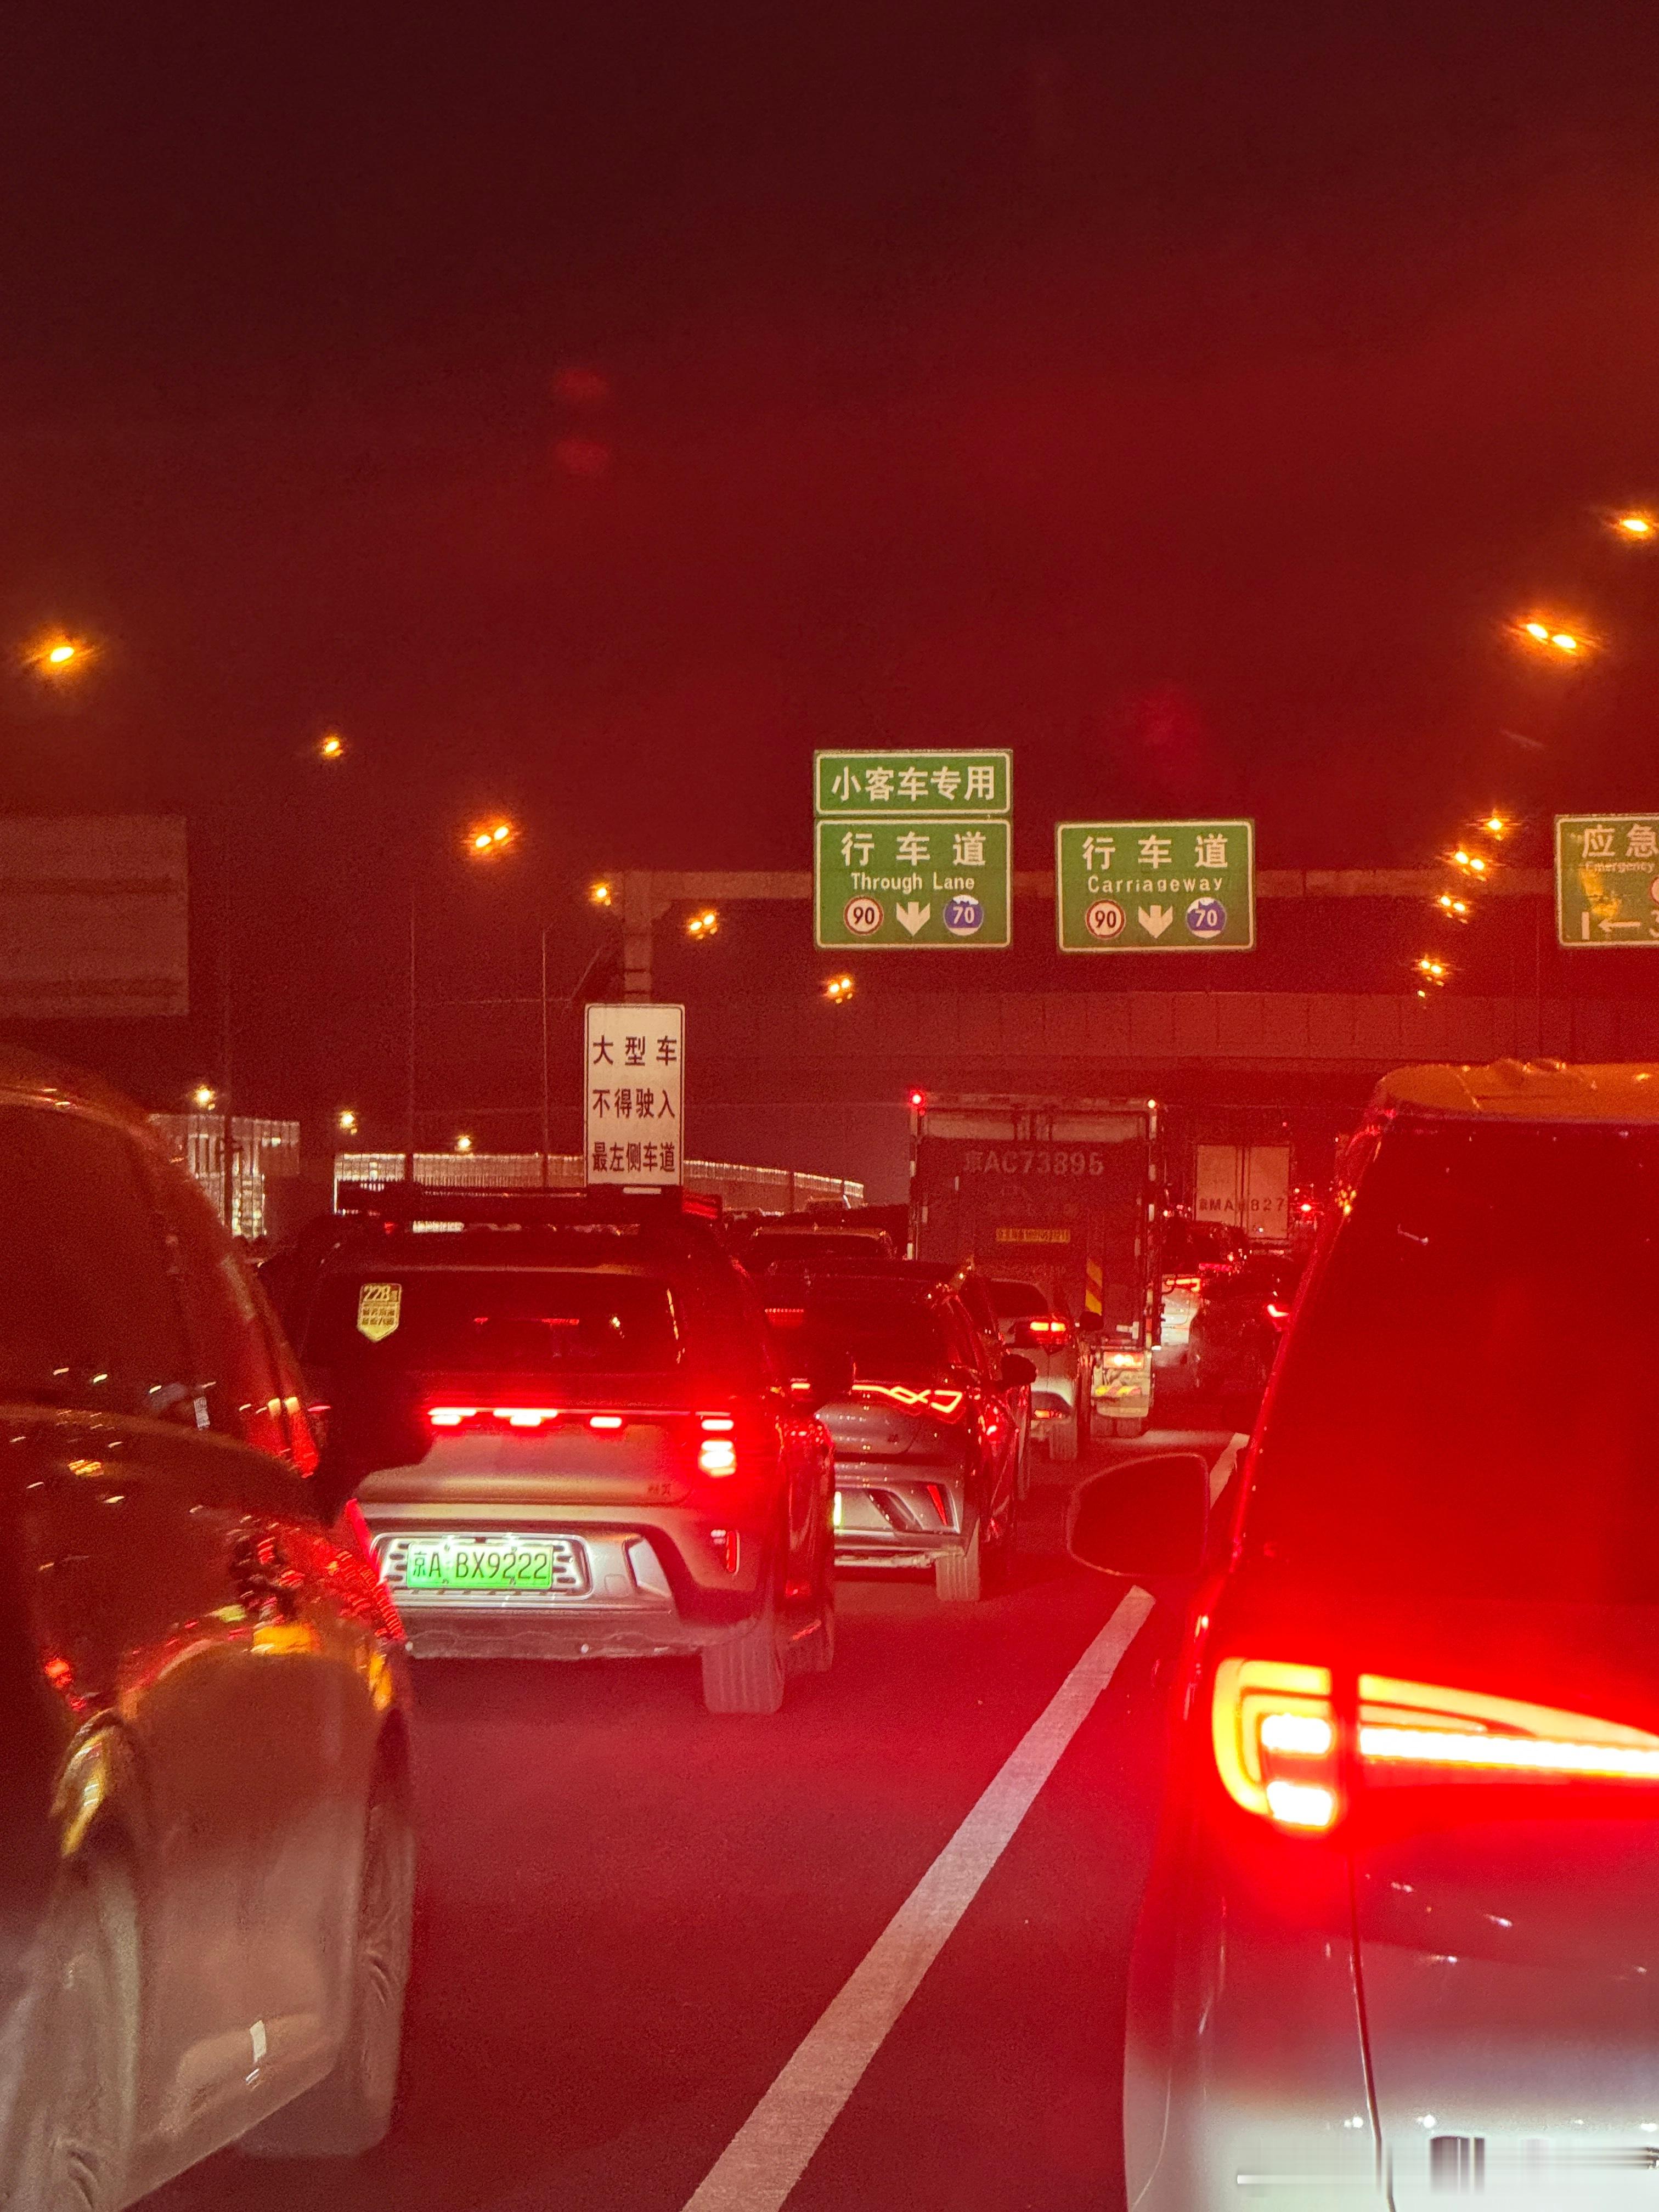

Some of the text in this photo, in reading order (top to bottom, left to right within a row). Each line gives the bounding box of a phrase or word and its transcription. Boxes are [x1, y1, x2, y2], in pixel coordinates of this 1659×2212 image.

[831, 766, 995, 801] 小客车专用
[841, 831, 986, 866] 行车道
[1082, 833, 1228, 870] 行车道
[851, 872, 975, 894] Through Lane
[1087, 876, 1222, 893] Carriageway
[853, 907, 875, 926] 90
[952, 906, 975, 924] 70
[1094, 910, 1116, 928] 90
[1194, 908, 1217, 928] 70
[592, 1035, 677, 1066] 大型车
[592, 1088, 675, 1119] 不得驶入
[592, 1142, 675, 1173] 最左侧车道
[456, 1552, 548, 1579] BX9222
